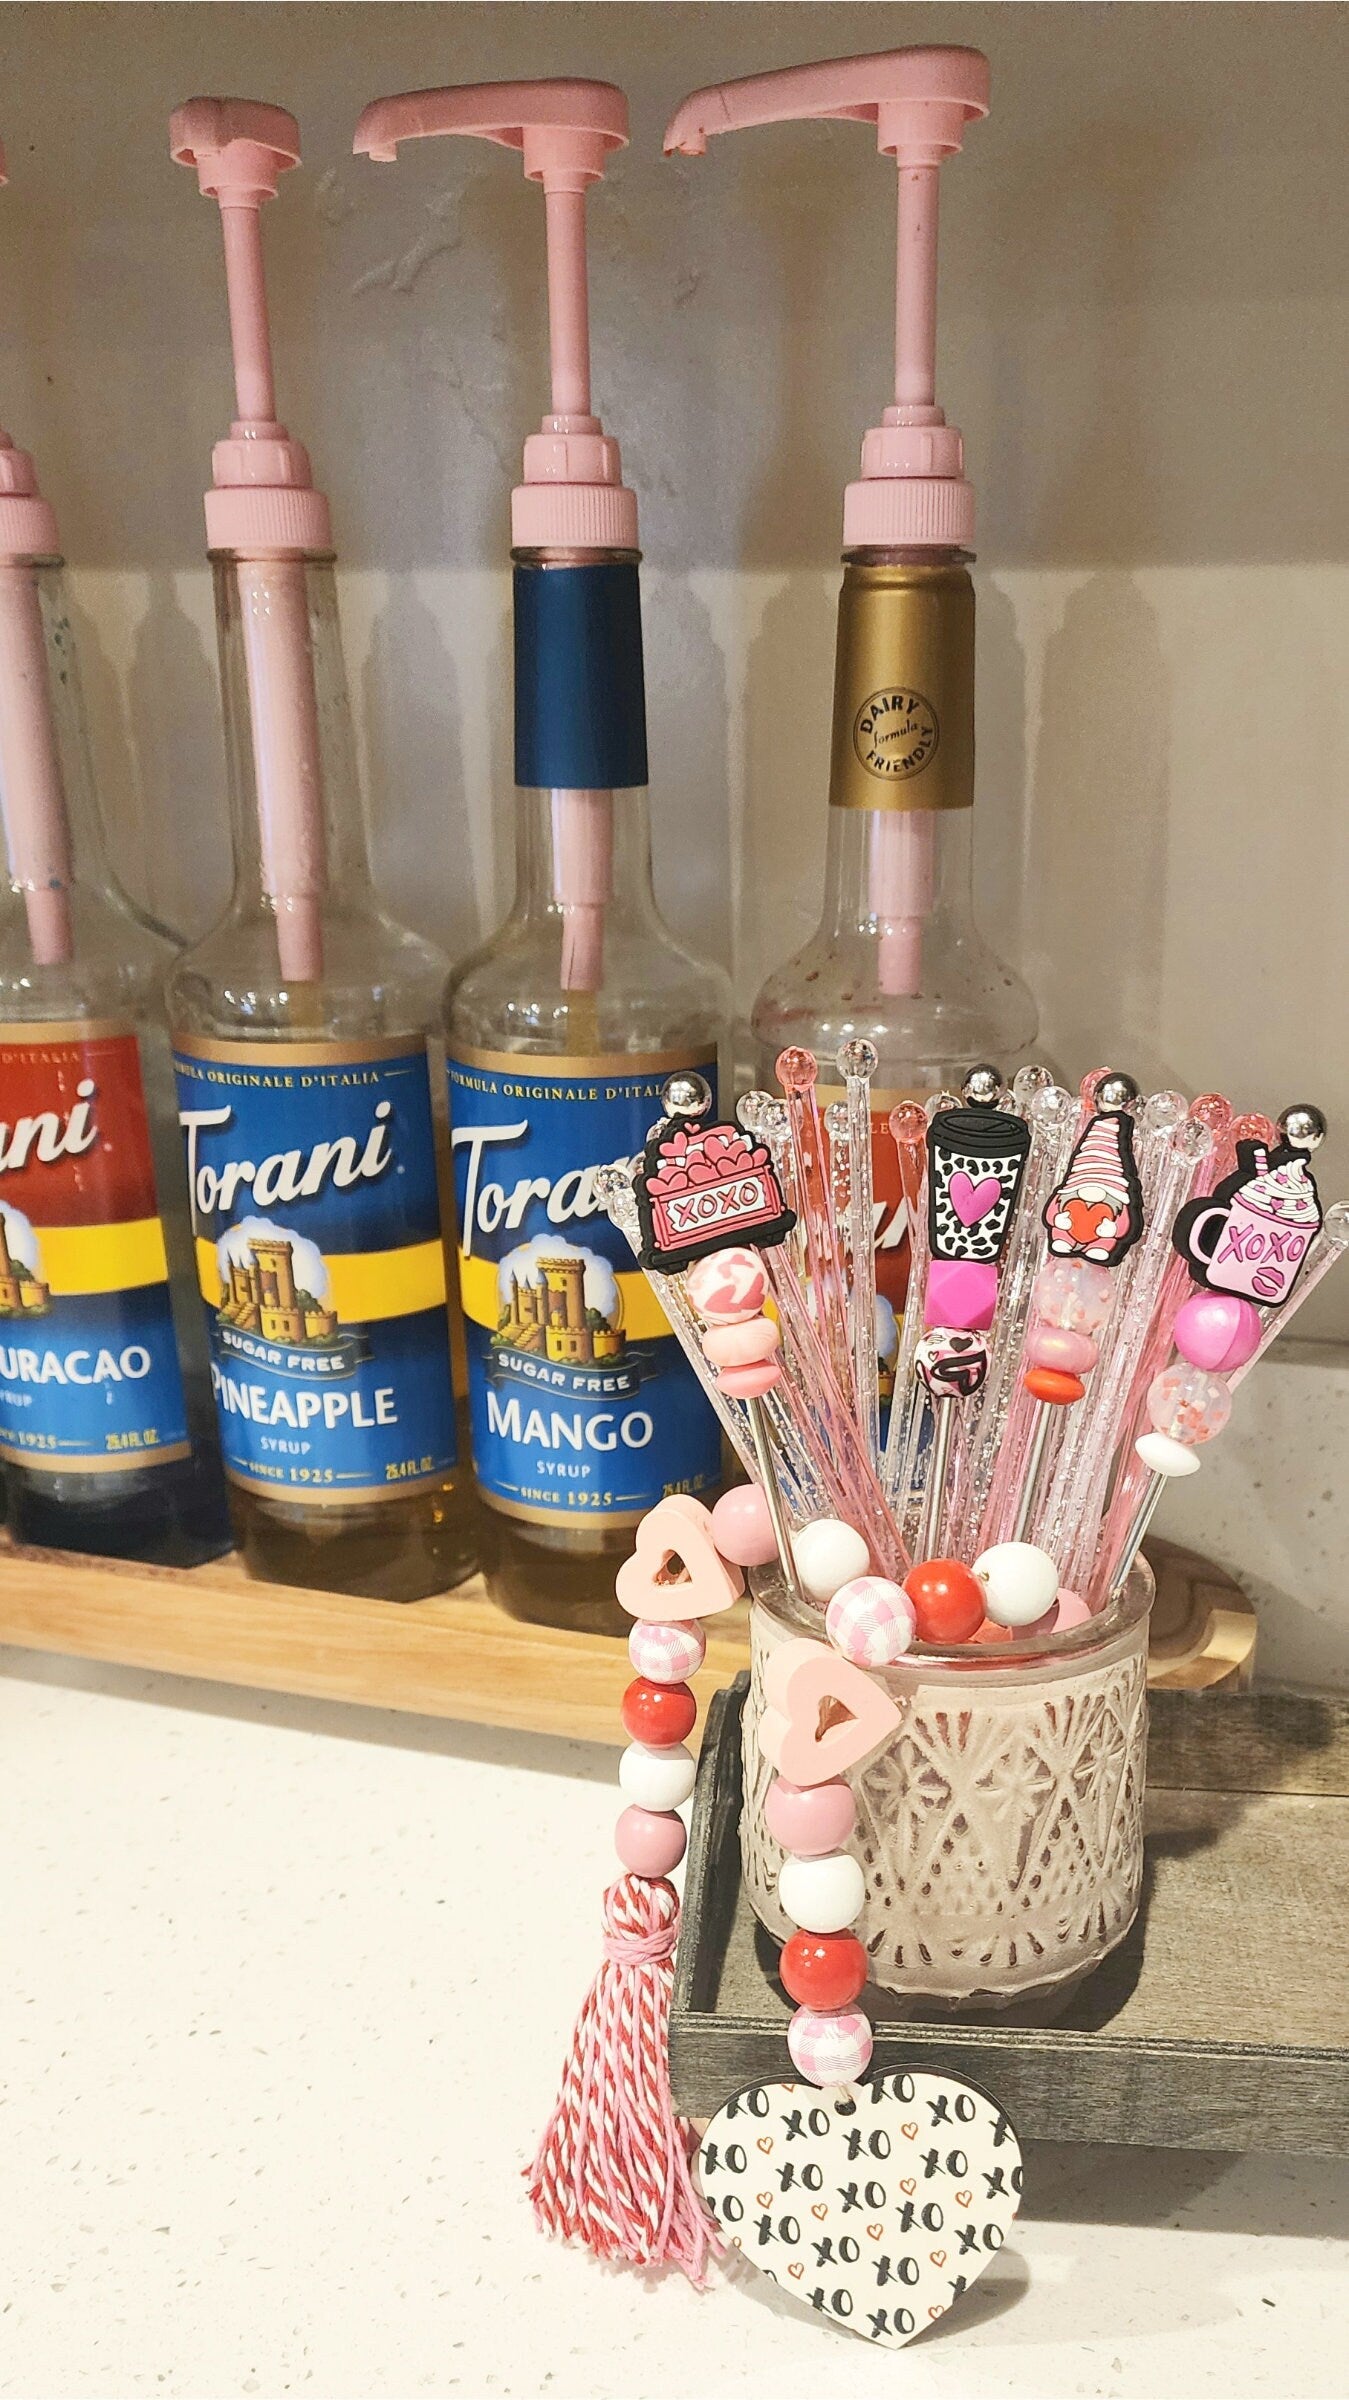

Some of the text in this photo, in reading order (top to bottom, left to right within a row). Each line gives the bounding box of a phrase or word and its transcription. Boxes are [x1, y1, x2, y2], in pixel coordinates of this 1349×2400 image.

[860, 695, 919, 734] DAIRY
[866, 726, 933, 772] FRIENDLY
[874, 719, 918, 748] formula
[207, 1071, 379, 1089] ORIGINALE D'ITALIA
[503, 1083, 598, 1101] ORIGINALE
[606, 1085, 662, 1100] D'ITAL
[179, 1101, 392, 1237] Torani
[451, 1119, 629, 1256] Tora
[674, 1182, 758, 1227] XOXO
[1217, 1223, 1305, 1264] XOXO
[0, 1345, 151, 1385] URACAO
[222, 1331, 345, 1372] SUGAR FREE
[498, 1353, 631, 1392] SUGAR FREE
[210, 1362, 398, 1429] PINEAPPLE
[486, 1391, 654, 1451] MANGO
[260, 1436, 311, 1455] SYRUP
[290, 1467, 333, 1483] 1925
[536, 1460, 591, 1478] SYRUP
[520, 1486, 560, 1504] SINCE
[567, 1491, 612, 1507] 1925
[780, 2108, 831, 2142] XO
[926, 2093, 977, 2128] XO
[700, 2143, 748, 2175] XO
[842, 2128, 892, 2161] XO
[775, 2162, 824, 2193] XO
[919, 2147, 969, 2179] XO
[836, 2181, 887, 2214] XO
[753, 2214, 802, 2246] XO
[895, 2200, 945, 2234] XO
[811, 2236, 861, 2268] XO
[954, 2223, 1005, 2256] XO
[872, 2255, 920, 2287] XO
[806, 2287, 854, 2318] XO
[866, 2307, 916, 2339] XO
